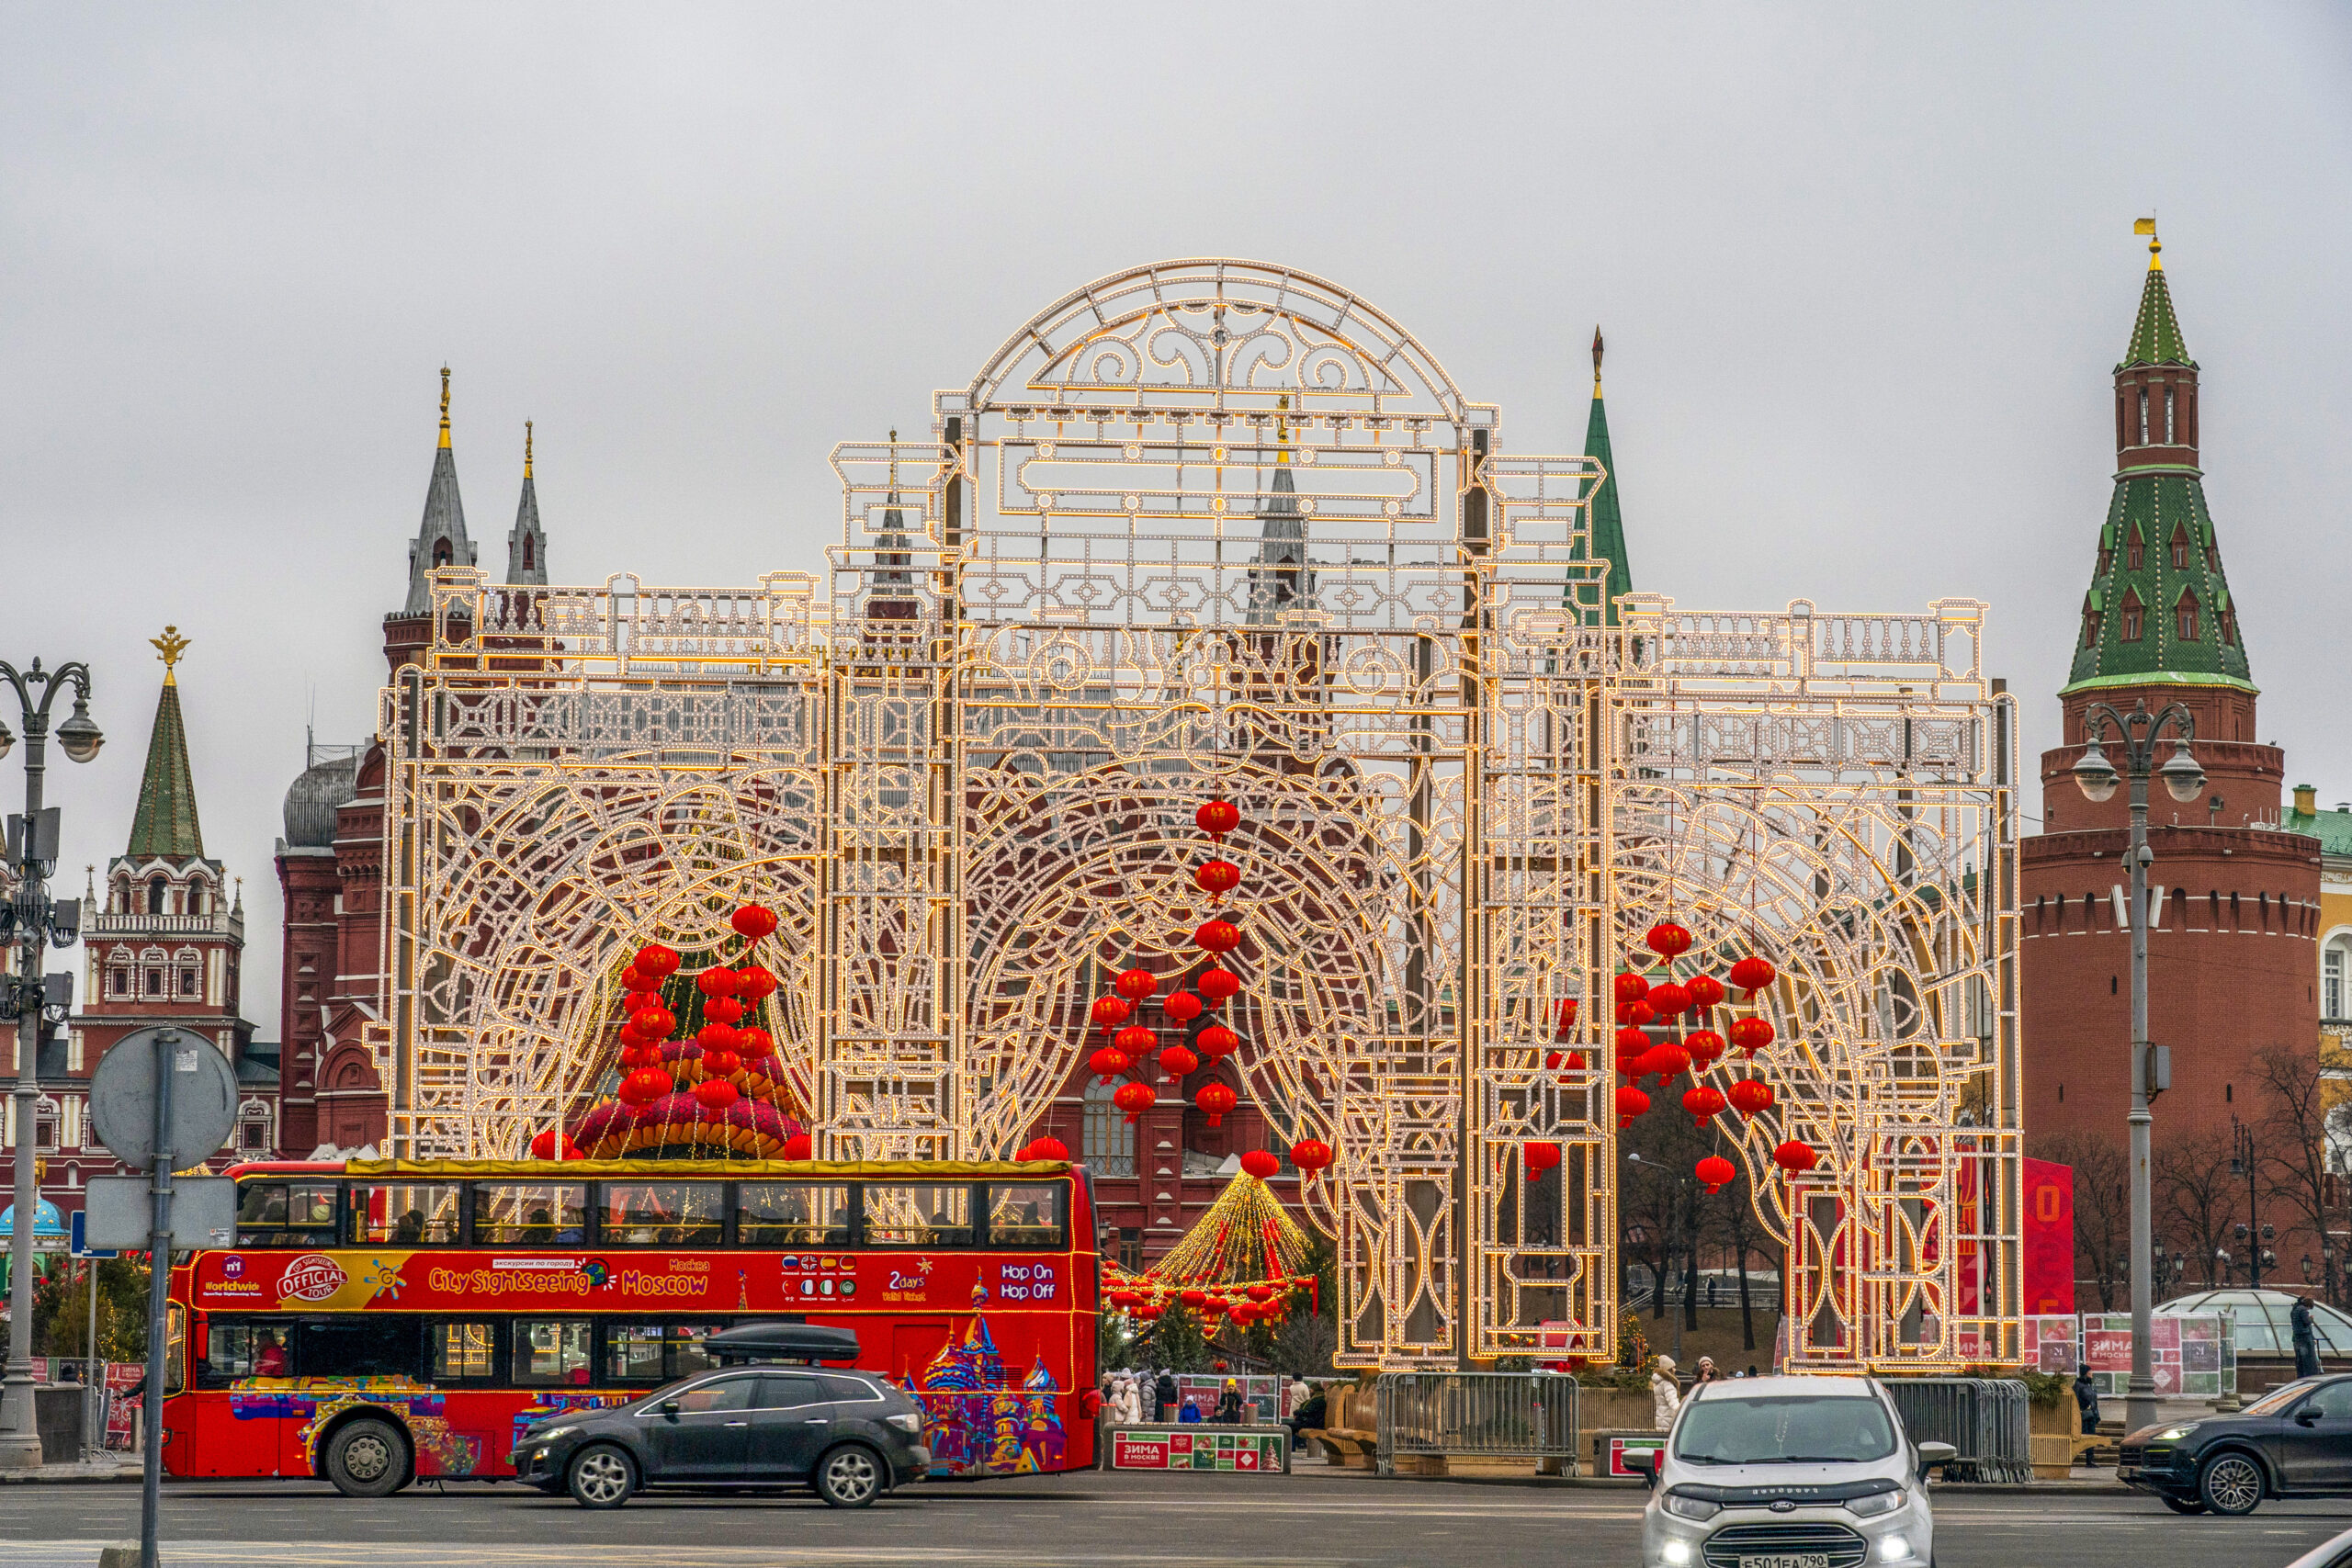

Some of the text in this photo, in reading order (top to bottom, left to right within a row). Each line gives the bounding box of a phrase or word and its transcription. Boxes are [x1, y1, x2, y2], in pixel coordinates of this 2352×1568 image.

[292, 1258, 334, 1272] CITY SIGHTSEEING
[668, 1258, 710, 1272] Москва
[1001, 1264, 1053, 1281] Hop On
[283, 1270, 346, 1293] OFFICIAL
[429, 1268, 591, 1295] City Sightseeing
[622, 1269, 708, 1295] Moscow
[308, 1284, 334, 1297] TOUR
[1001, 1283, 1055, 1300] Hop Off
[1124, 1444, 1159, 1454] ЗИМА
